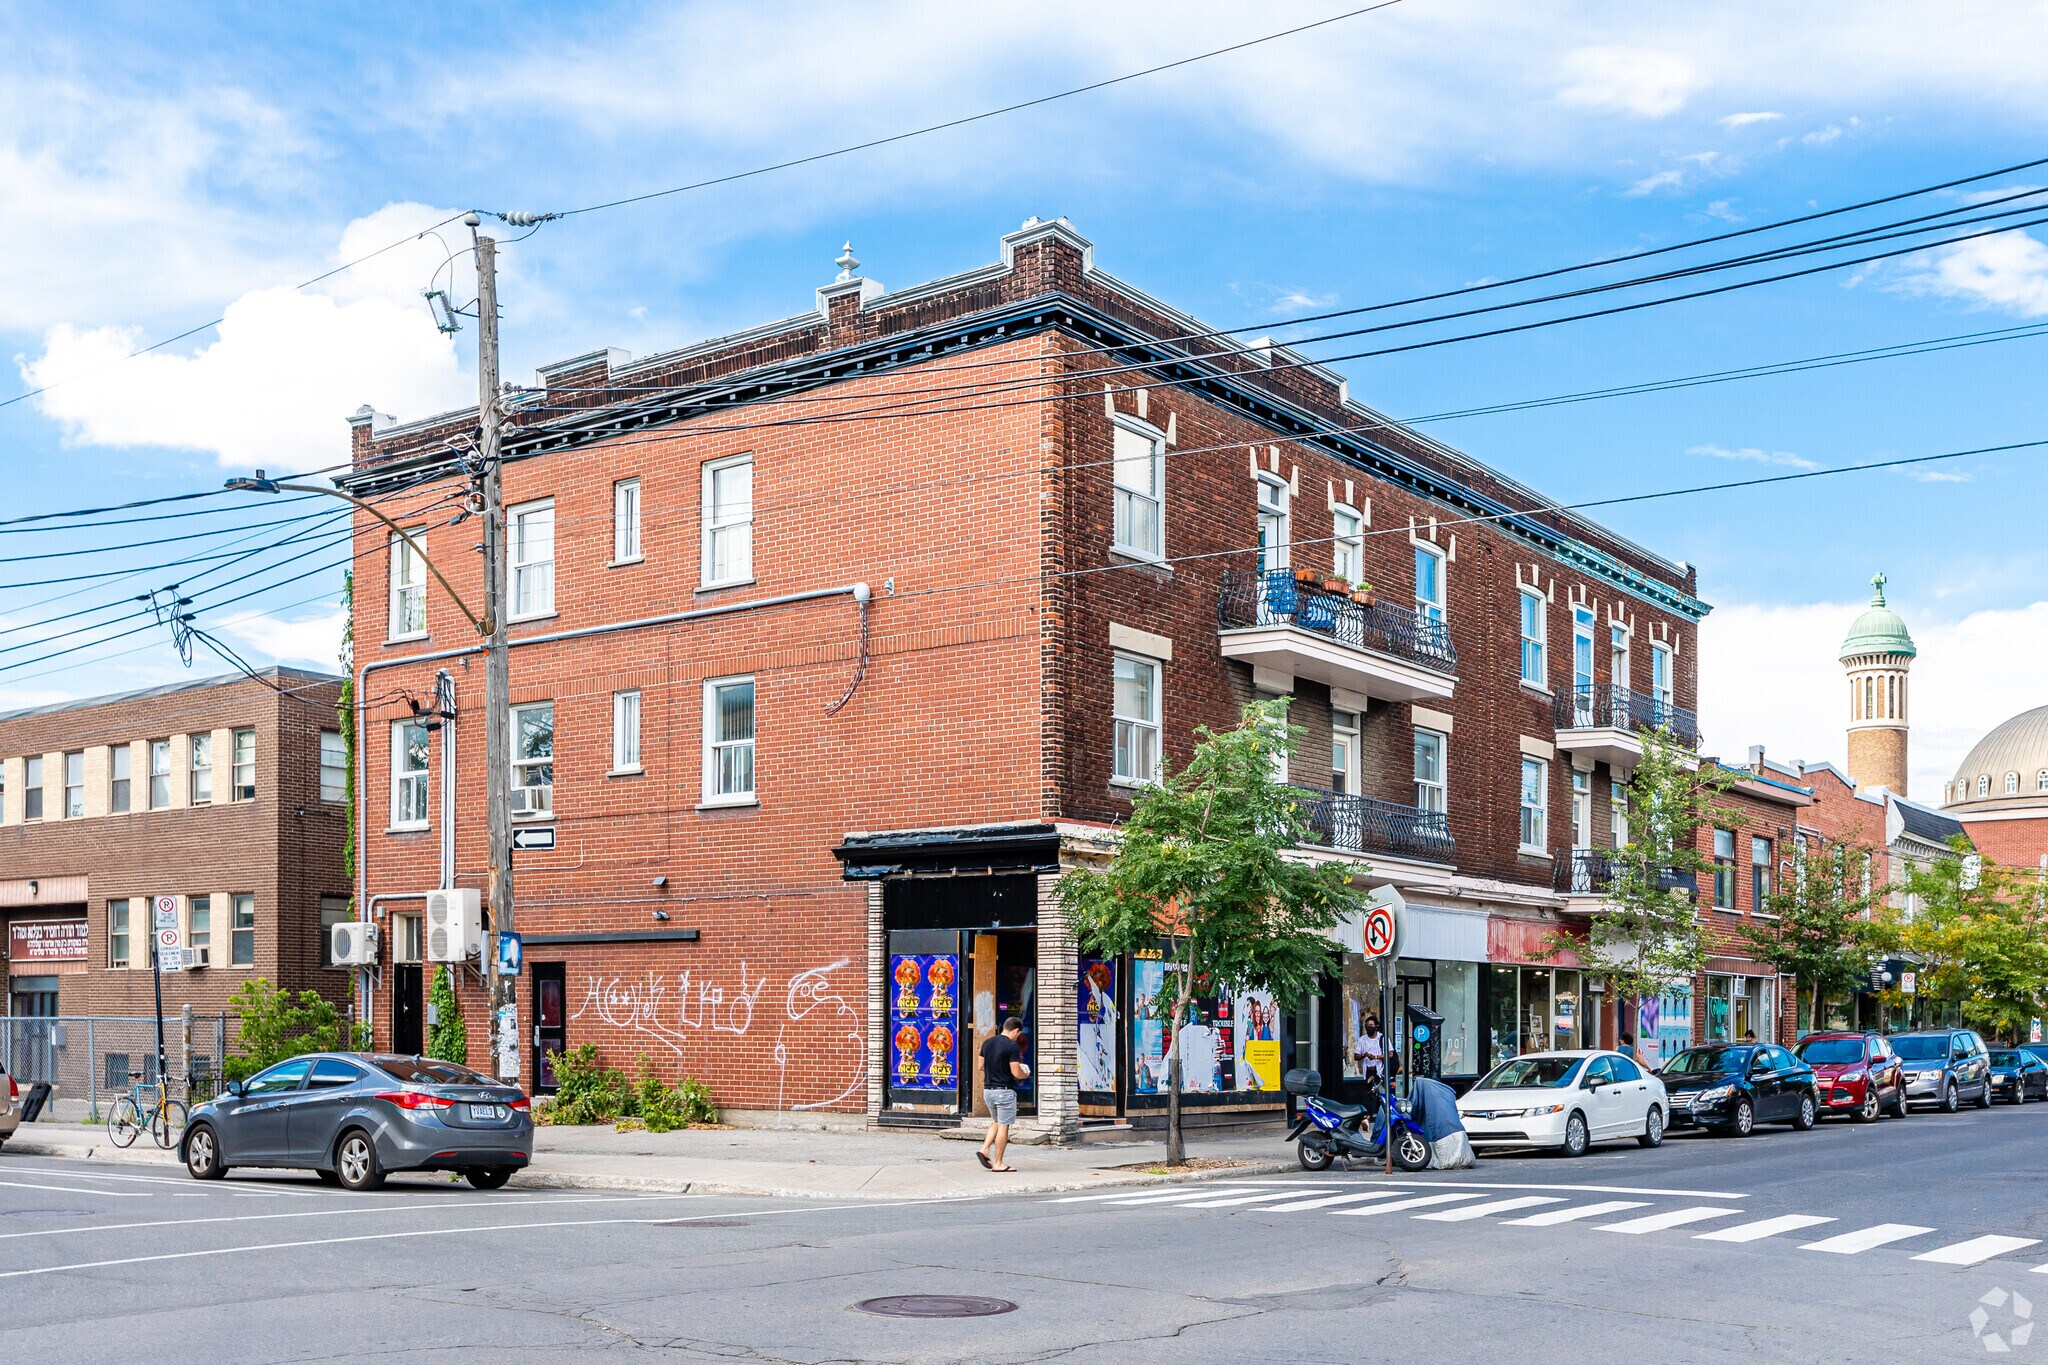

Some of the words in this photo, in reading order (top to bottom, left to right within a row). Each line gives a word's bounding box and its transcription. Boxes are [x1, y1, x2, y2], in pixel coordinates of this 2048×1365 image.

[897, 999, 919, 1008] INCAS
[930, 1000, 952, 1008] INCAS
[1212, 1019, 1234, 1027] TROUBLE
[1418, 1028, 1425, 1038] P
[898, 1065, 919, 1073] INCAS
[930, 1066, 951, 1075] INCAS
